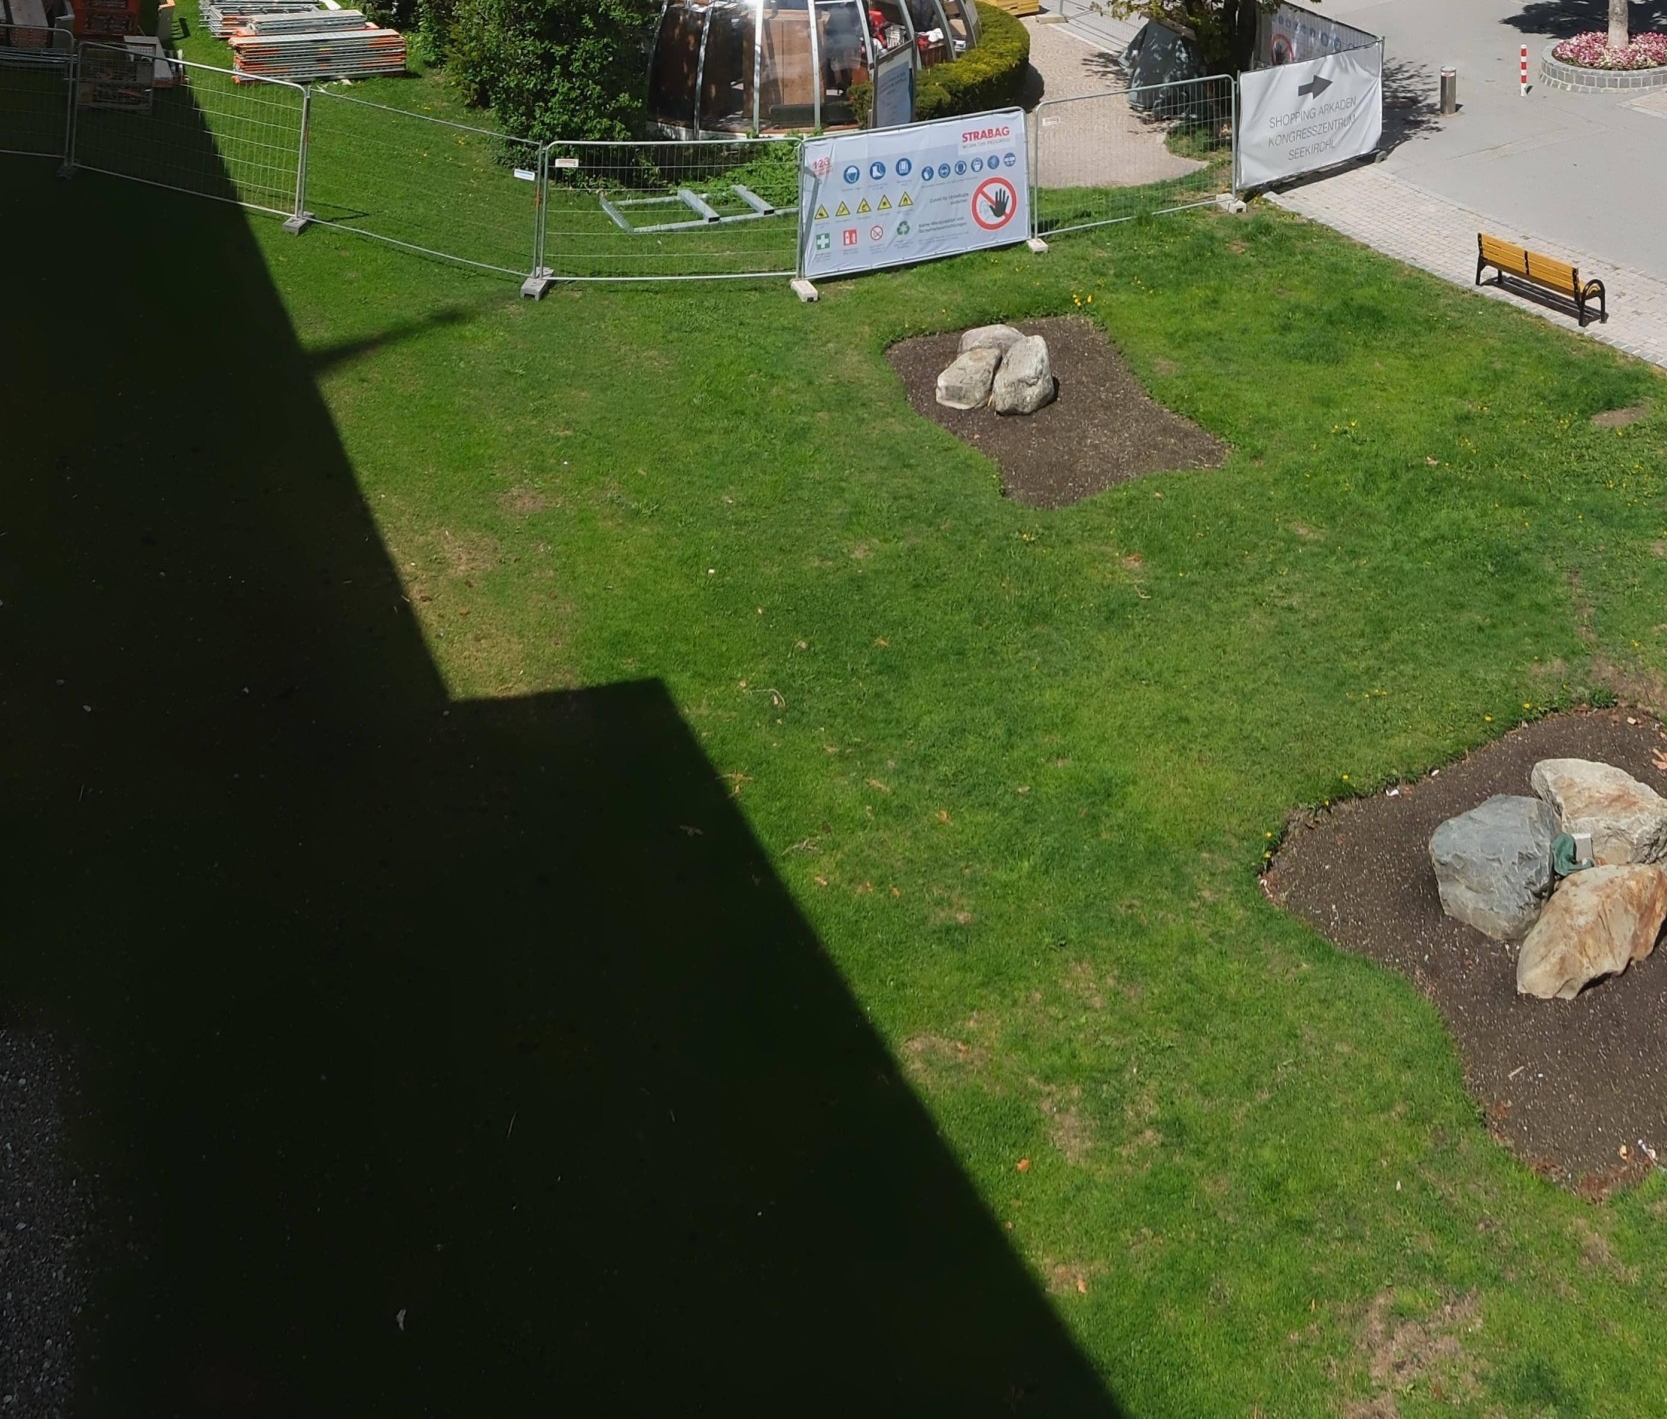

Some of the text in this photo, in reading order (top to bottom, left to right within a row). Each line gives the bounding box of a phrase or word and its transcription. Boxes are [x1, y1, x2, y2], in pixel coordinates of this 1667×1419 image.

[1269, 96, 1357, 129] SHOPPING ARKADEN
[962, 126, 1010, 143] STRABAG
[1288, 138, 1336, 161] SEEKIRCHL
